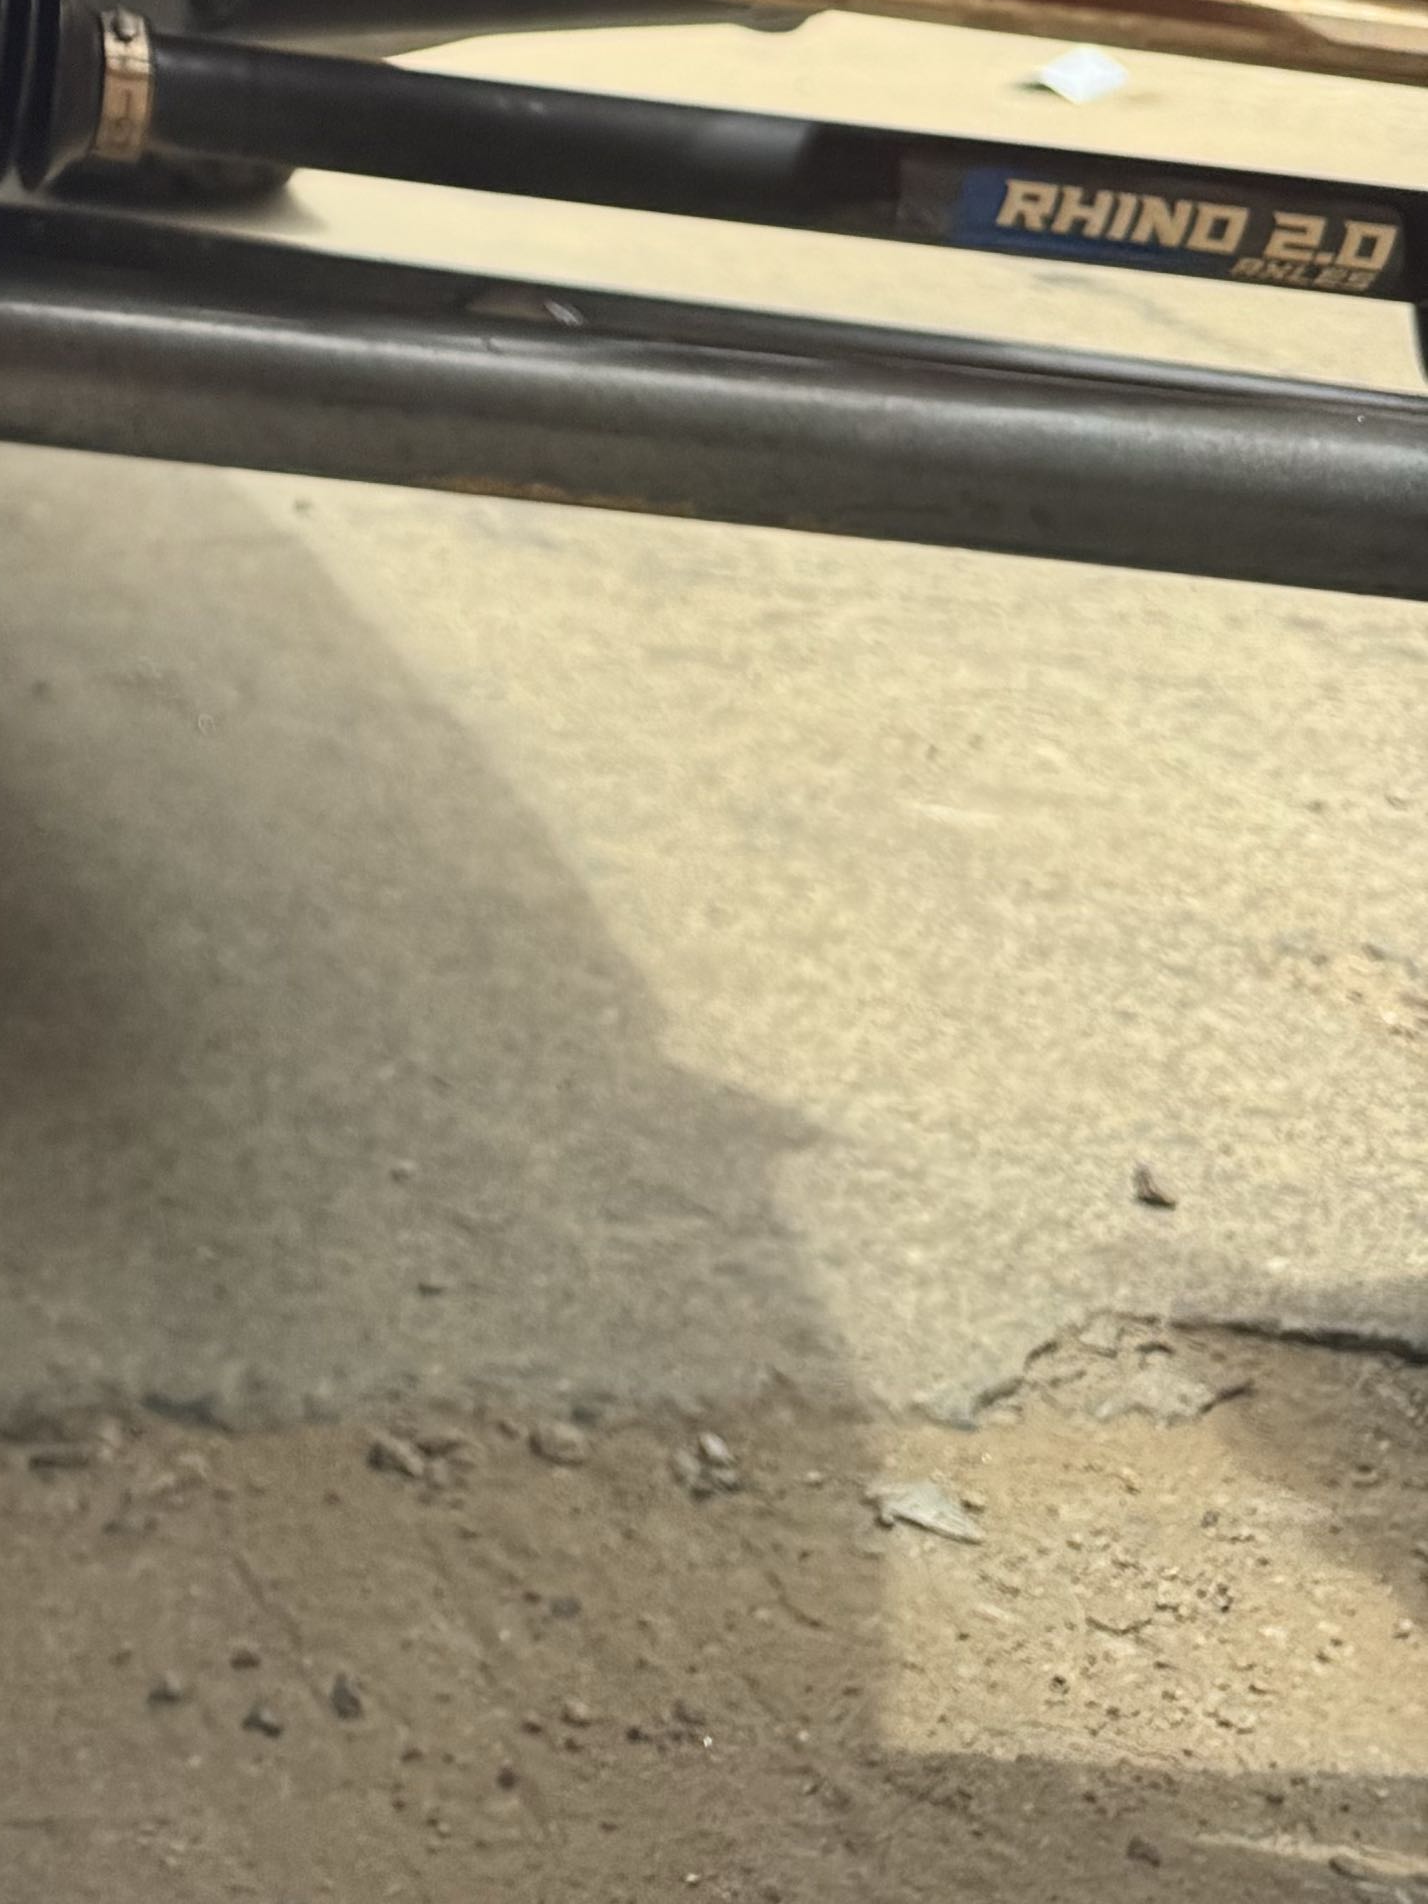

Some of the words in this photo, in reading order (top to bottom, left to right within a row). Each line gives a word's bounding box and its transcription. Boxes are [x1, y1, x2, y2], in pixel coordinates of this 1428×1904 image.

[995, 178, 1249, 256] RHINO
[1262, 210, 1398, 272] 2.0
[1228, 256, 1379, 293] AXLES
